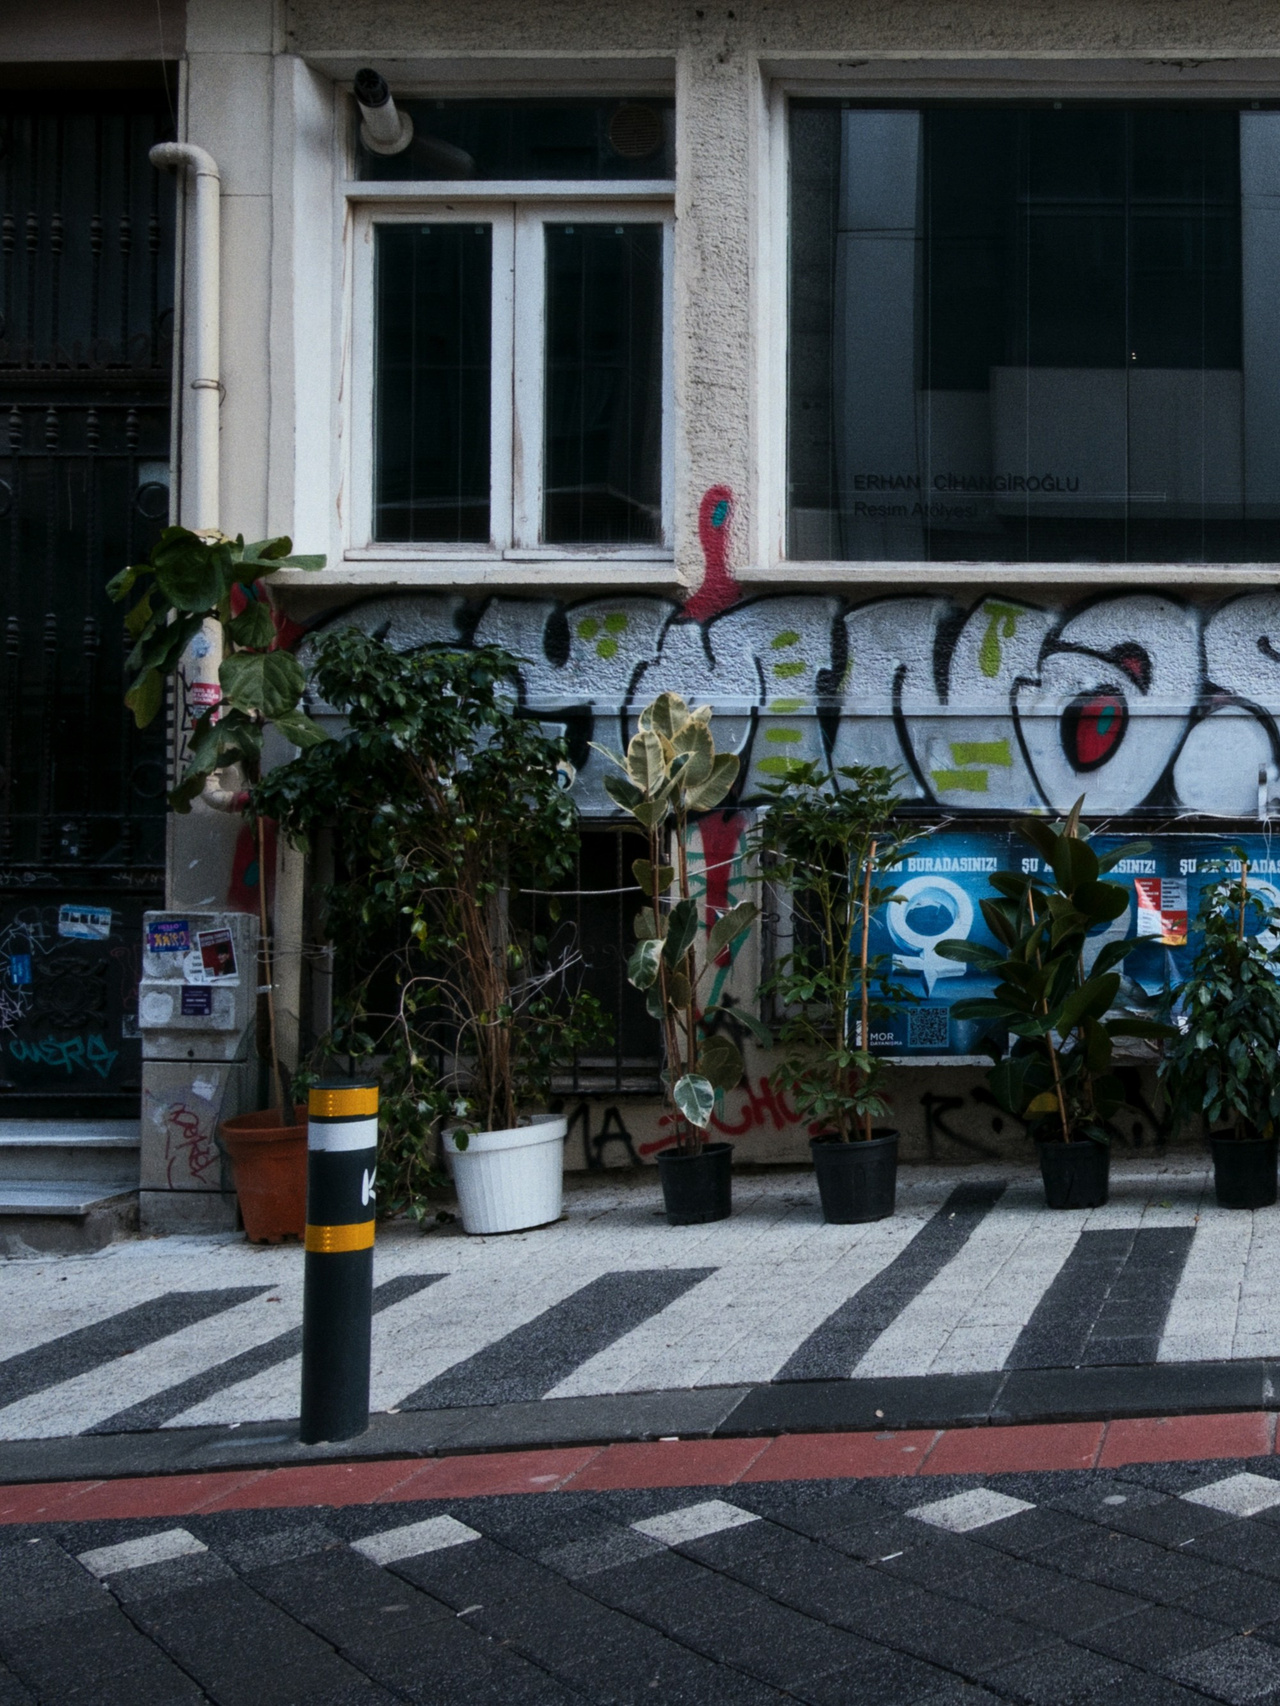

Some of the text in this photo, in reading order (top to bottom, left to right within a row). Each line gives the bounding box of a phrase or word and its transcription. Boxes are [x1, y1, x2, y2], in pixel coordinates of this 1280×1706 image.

[854, 474, 920, 490] ERHAN
[854, 502, 906, 517] Resim
[907, 857, 998, 872] BURADASINIZ!
[1021, 858, 1039, 875] ŞU
[1179, 858, 1197, 876] ŞU
[870, 1032, 894, 1041] MOR
